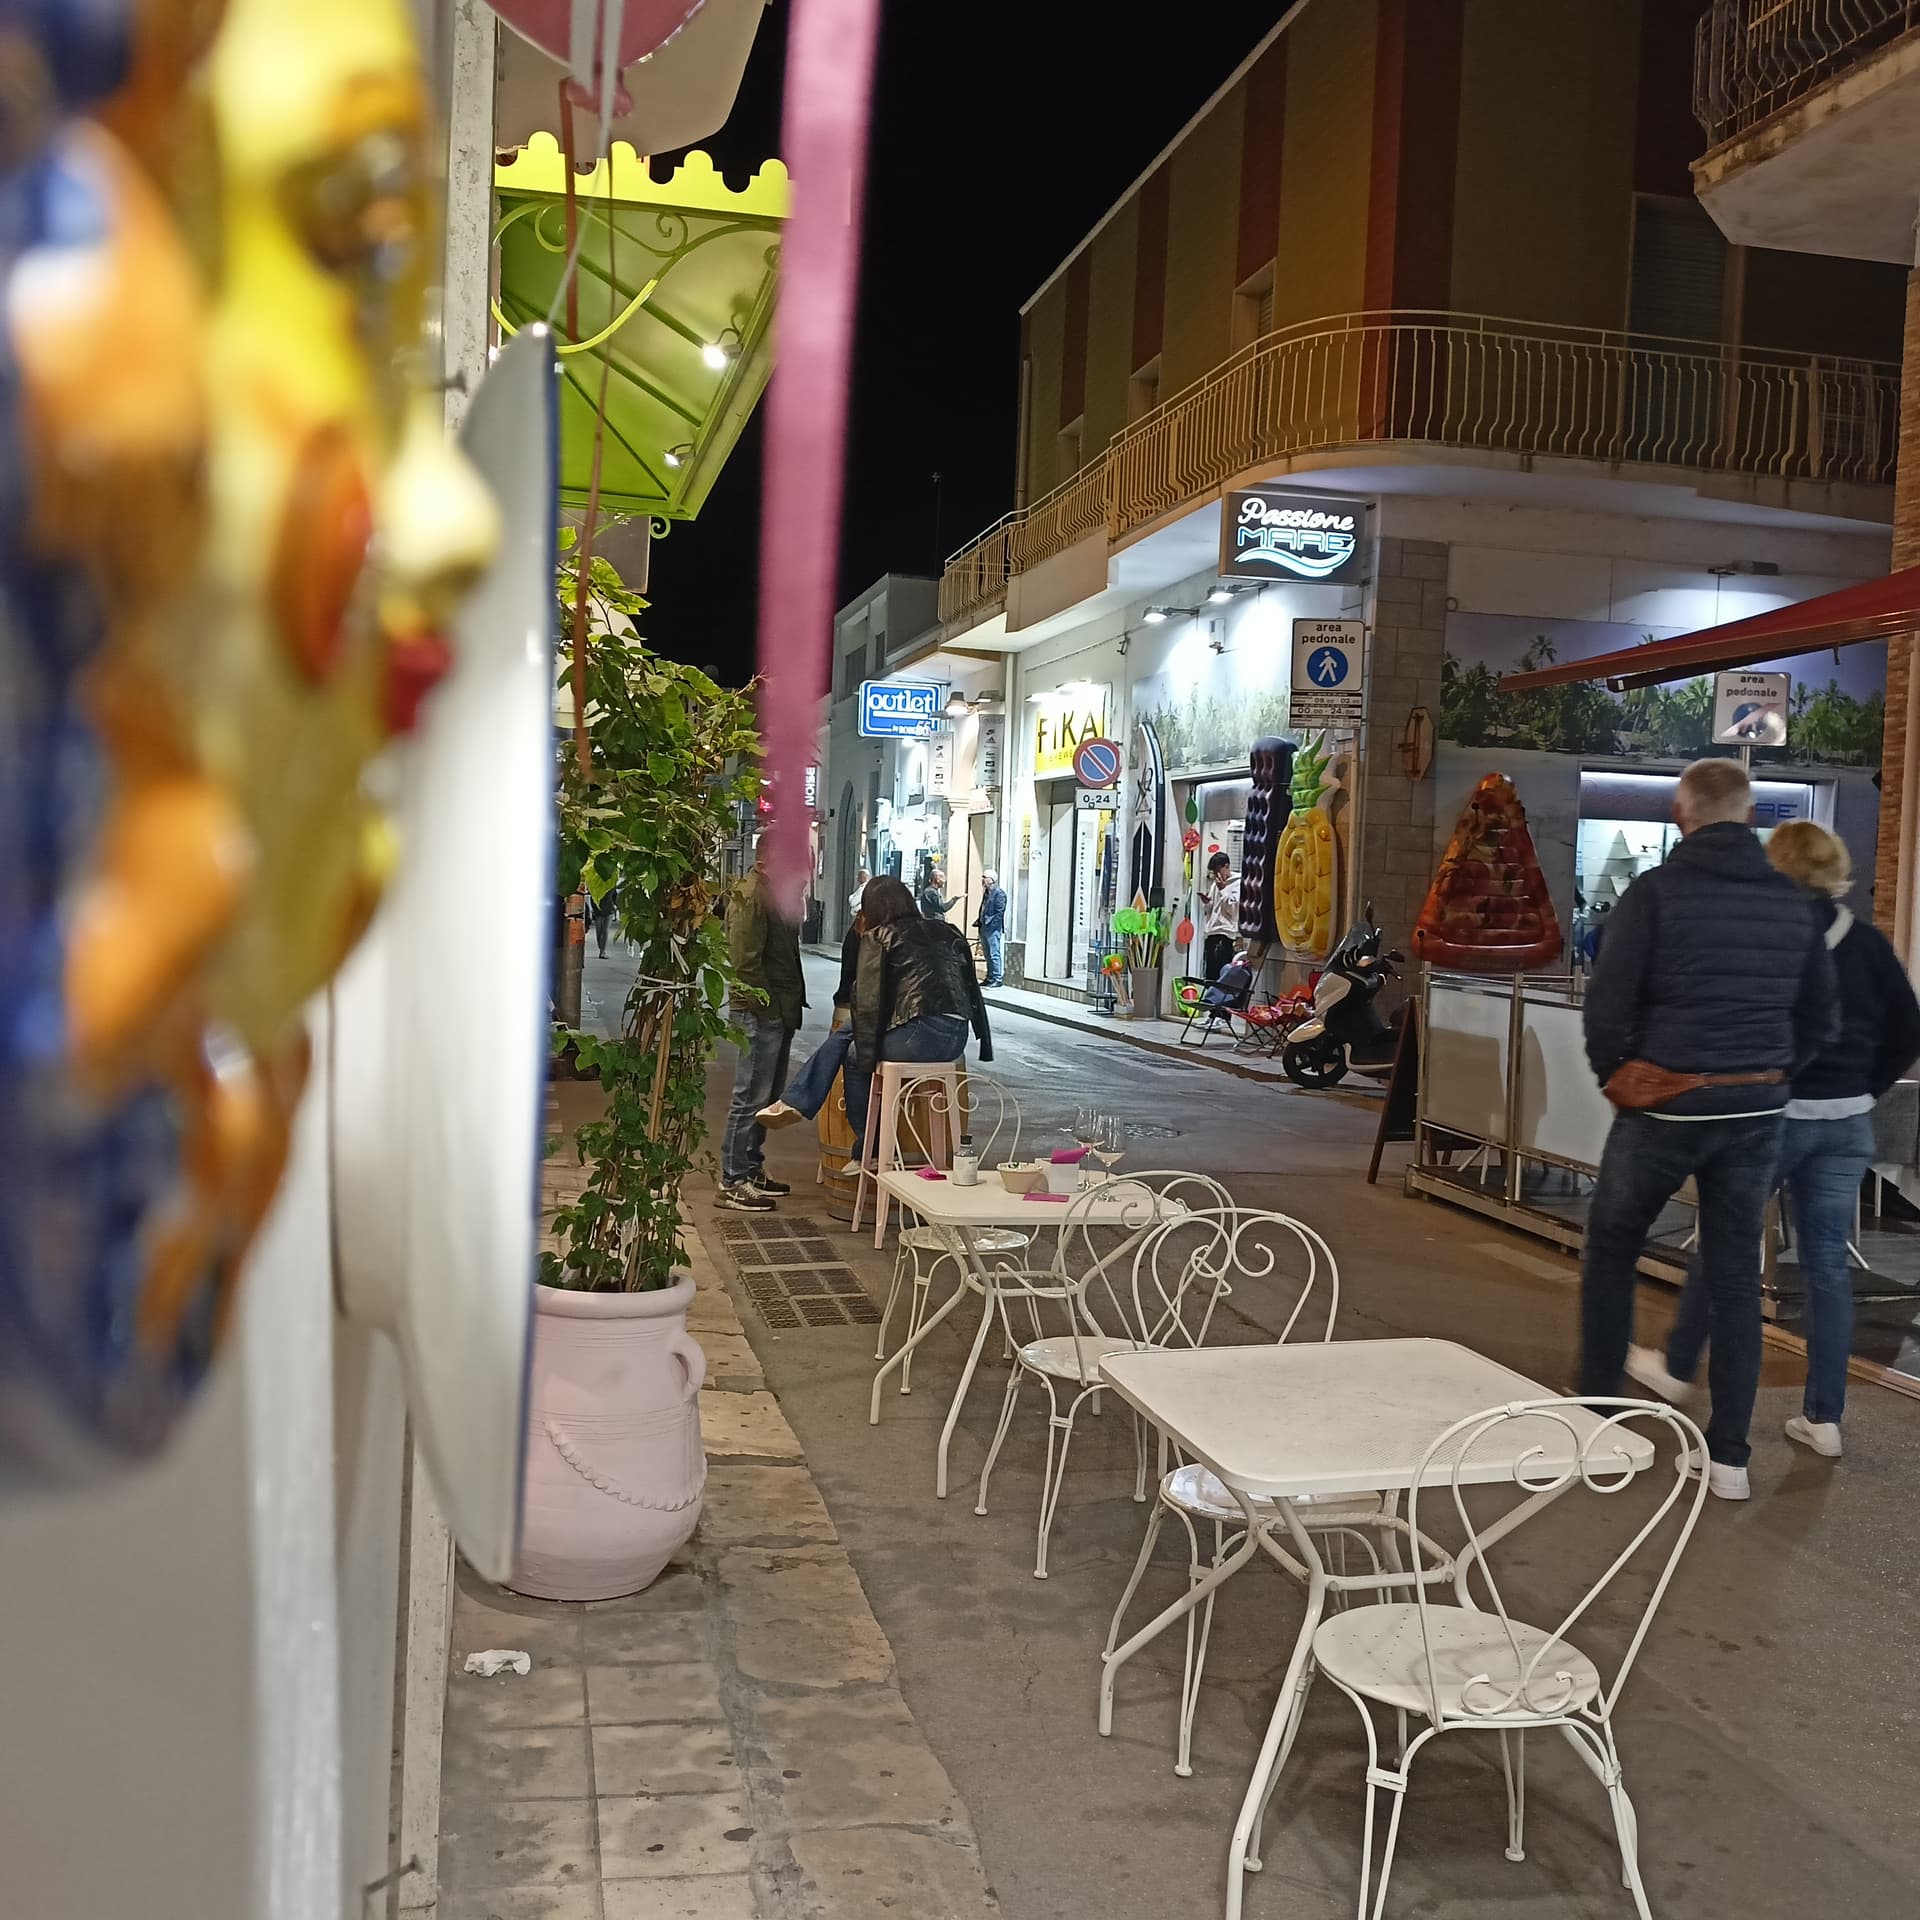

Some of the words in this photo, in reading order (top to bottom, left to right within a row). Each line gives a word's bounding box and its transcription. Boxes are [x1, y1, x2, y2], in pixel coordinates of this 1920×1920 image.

[1238, 497, 1354, 530] Passione
[1316, 624, 1342, 632] area
[1302, 634, 1356, 644] pedonale
[1740, 676, 1765, 684] area
[1726, 688, 1778, 697] pedonale
[869, 690, 932, 713] outlet
[1038, 710, 1098, 753] FIKA
